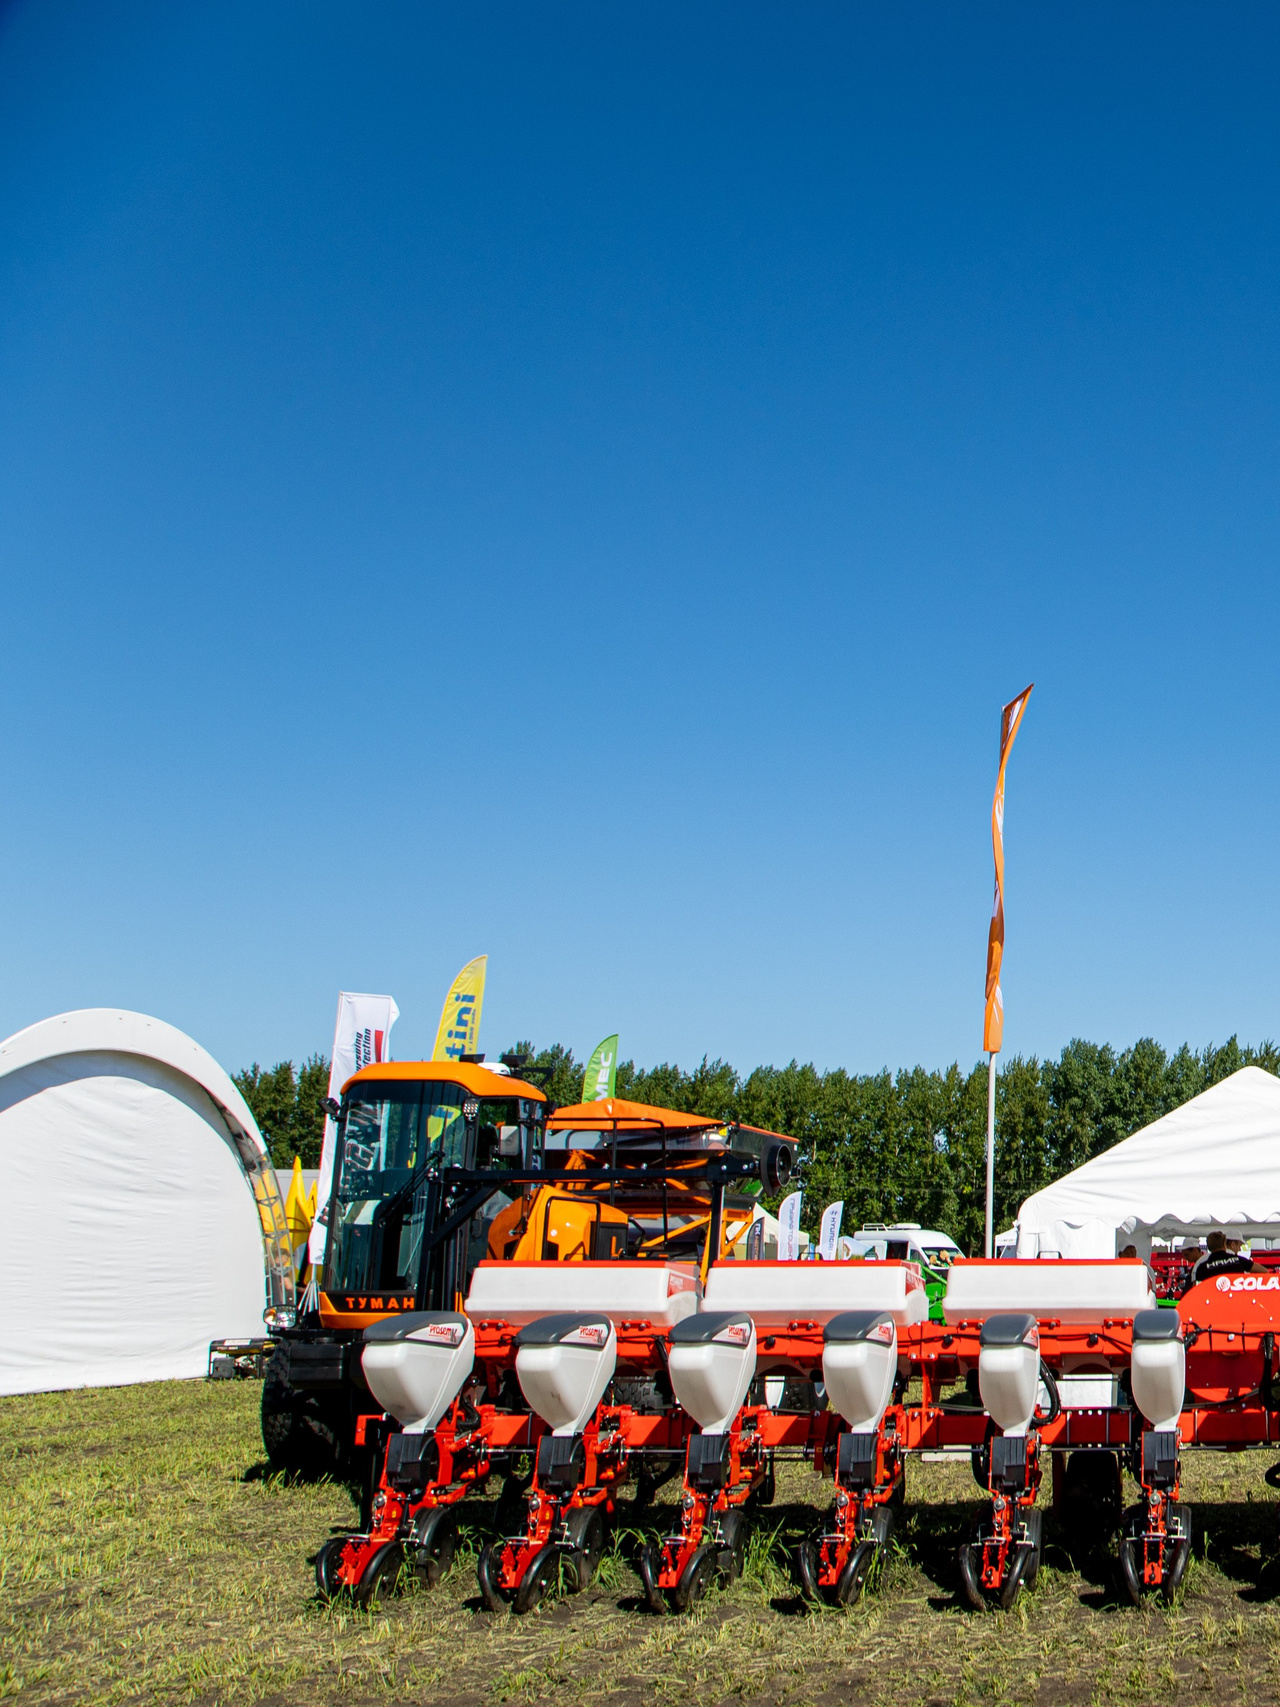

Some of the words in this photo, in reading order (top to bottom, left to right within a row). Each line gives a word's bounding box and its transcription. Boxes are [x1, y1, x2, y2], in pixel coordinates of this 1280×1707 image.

[445, 992, 476, 1059] tini
[1230, 1276, 1280, 1291] SOLA
[345, 1297, 415, 1309] ТУМАН
